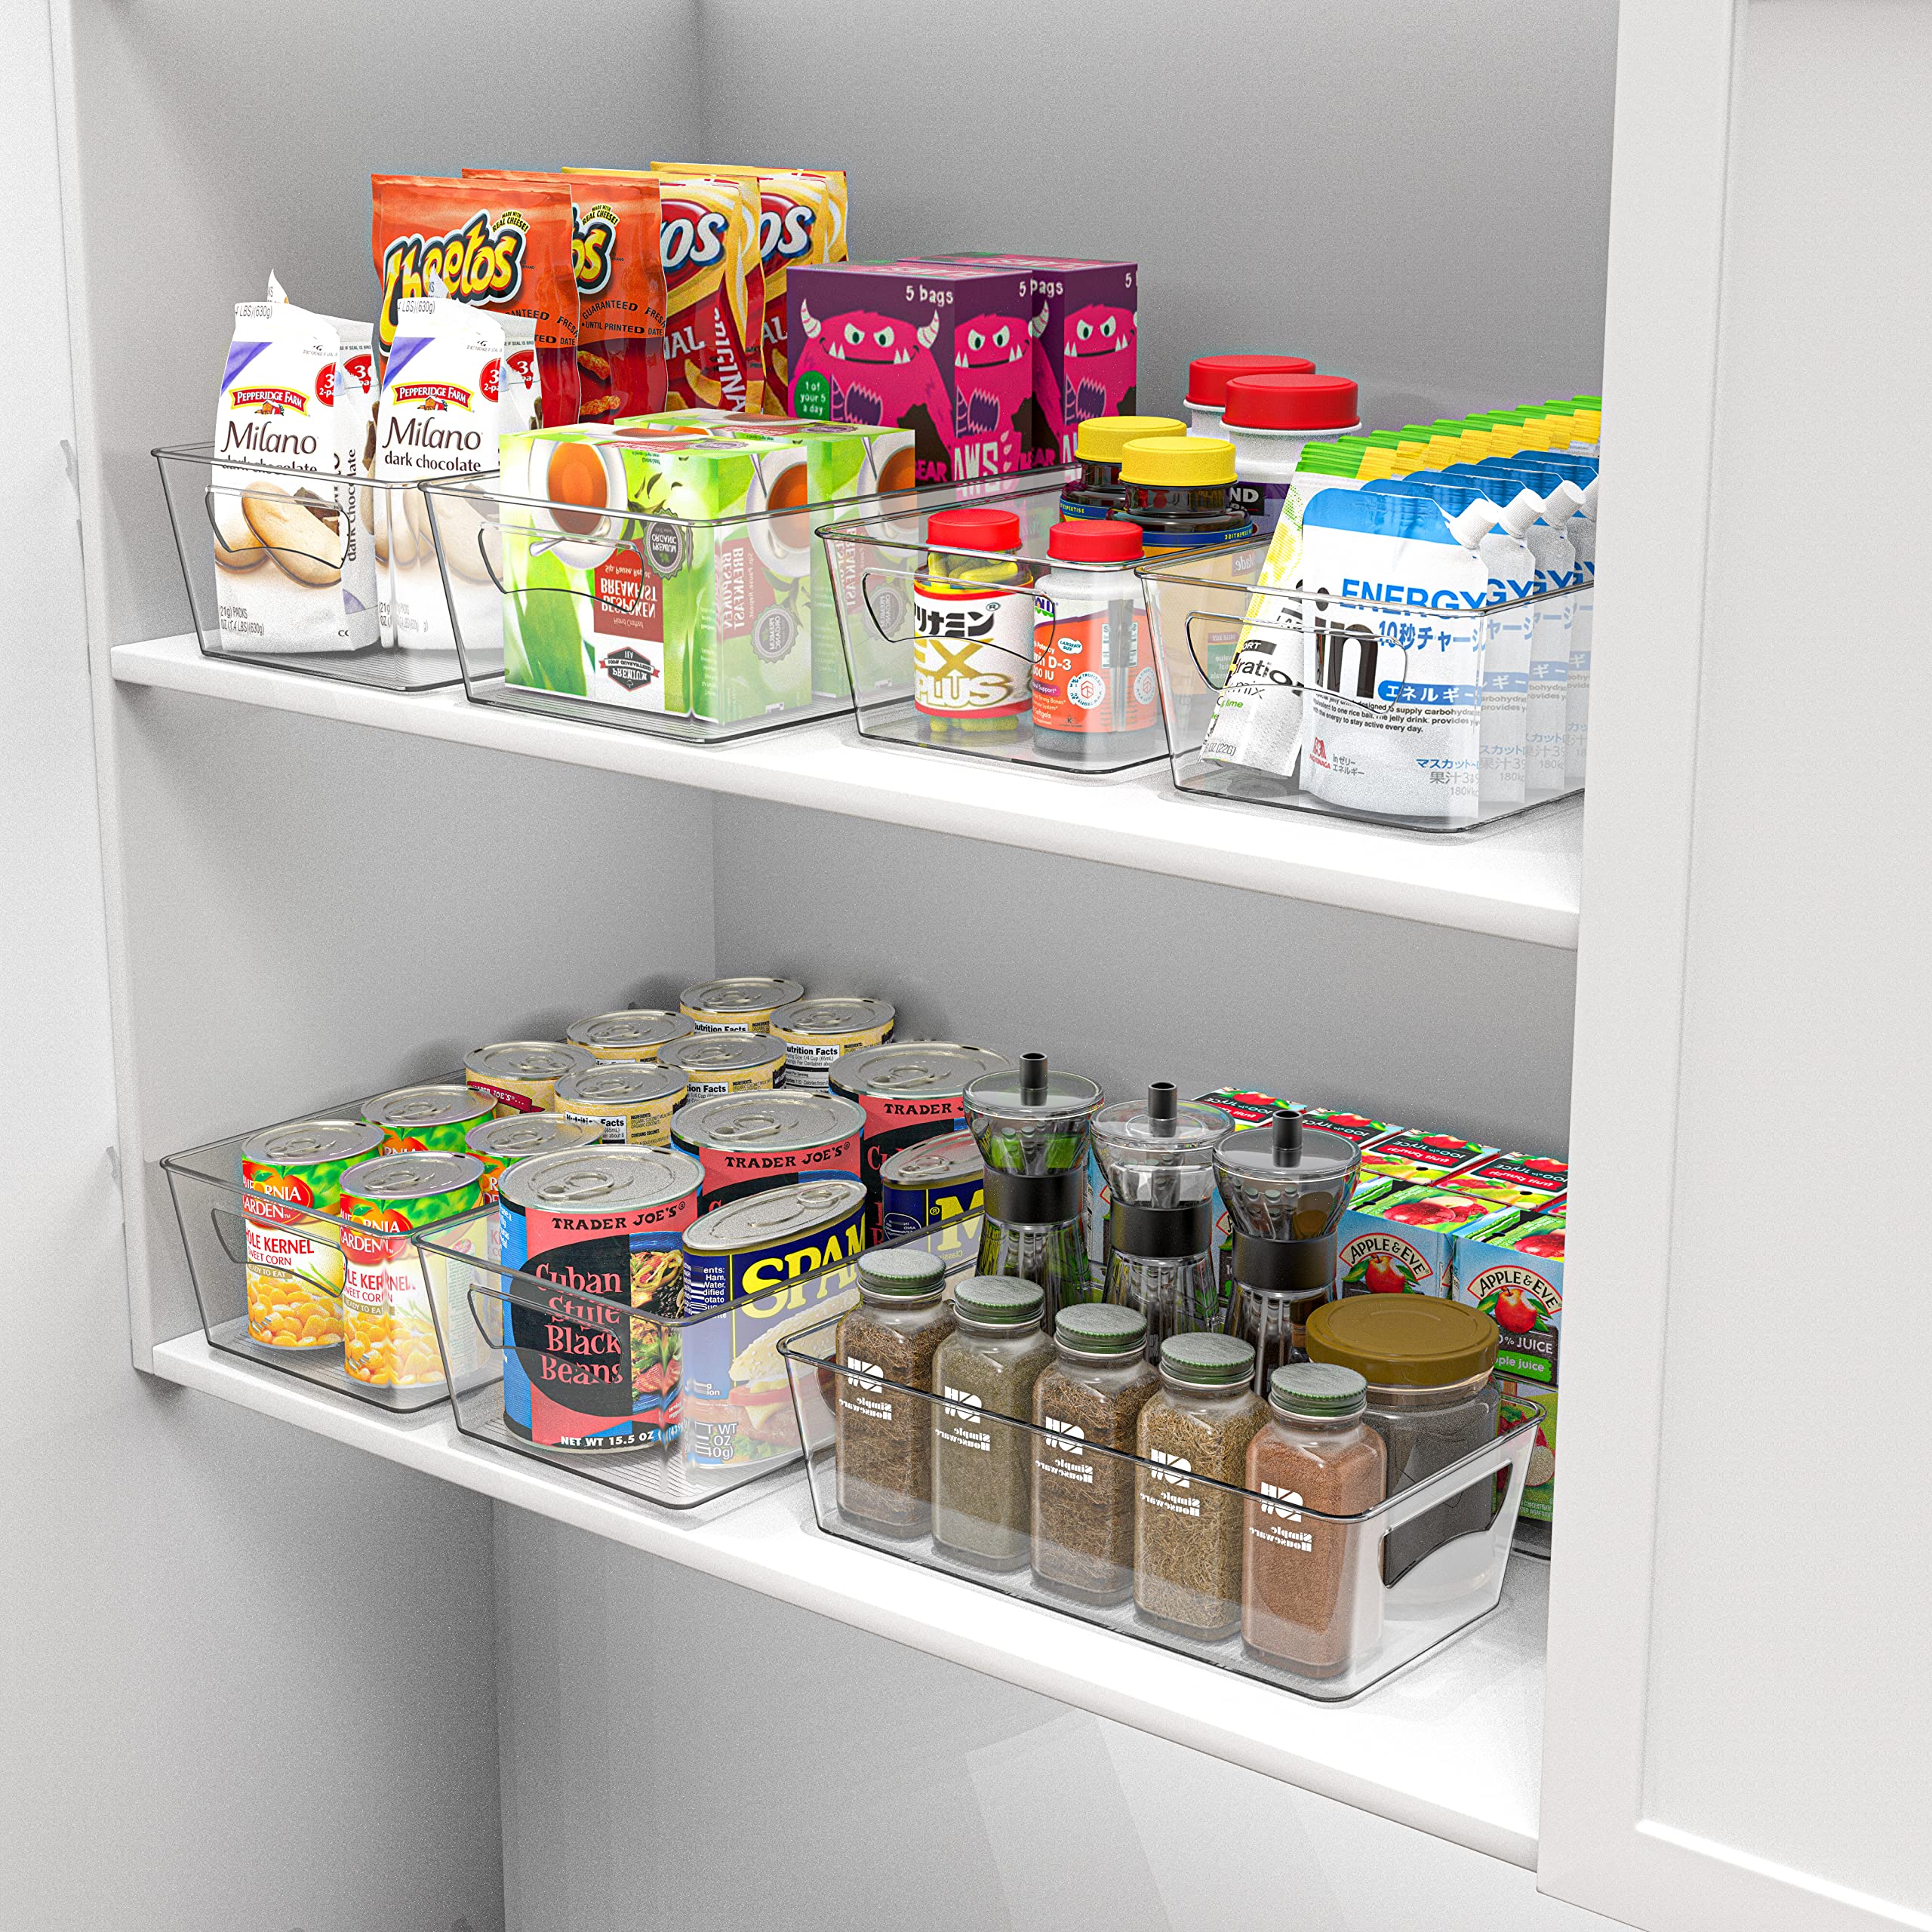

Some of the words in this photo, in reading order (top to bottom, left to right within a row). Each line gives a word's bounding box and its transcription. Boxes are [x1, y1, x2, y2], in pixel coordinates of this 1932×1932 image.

[492, 218, 506, 232] REAL
[506, 217, 528, 232] CHEESE!
[582, 214, 595, 225] REAL
[597, 210, 617, 225] CHEESE!
[1125, 274, 1132, 288] 5
[906, 285, 915, 300] 5
[920, 285, 953, 308] bags
[1019, 282, 1026, 297] 5
[582, 300, 638, 320] GUARANTEED
[586, 321, 603, 330] UNTIL
[605, 322, 645, 334] PRINTED
[648, 328, 663, 336] DATE
[560, 337, 575, 346] DATE
[811, 382, 820, 391] of
[237, 390, 283, 403] PEPPERIDGE
[285, 392, 302, 407] FARM
[399, 386, 446, 399] PEPPERIDGE
[448, 386, 466, 403] FARM
[800, 393, 819, 403] your
[820, 393, 826, 402] 5
[809, 405, 823, 414] day
[220, 420, 318, 455] Milano
[382, 417, 481, 451] Milano
[384, 451, 412, 467] dark
[416, 454, 481, 472] chocolate
[1340, 579, 1487, 620] ENERGY
[233, 606, 248, 620] PACKS
[1048, 656, 1072, 670] D-3
[1044, 669, 1054, 681] IU
[915, 672, 1014, 708] PLUS
[1226, 699, 1244, 708] lime
[1349, 709, 1360, 717] rice
[1396, 708, 1422, 716] supply
[1350, 717, 1363, 726] stay
[1364, 719, 1384, 729] active
[1385, 723, 1404, 733] every
[1407, 725, 1424, 734] day.
[786, 1046, 814, 1055] utrition
[703, 1084, 727, 1093] Facts
[884, 1103, 952, 1115] TRADER
[601, 1118, 624, 1127] Facts
[725, 1155, 795, 1169] TRADER
[801, 1143, 843, 1164] JOE'S
[552, 1217, 626, 1231] TRADER
[632, 1206, 678, 1226] JOE'S
[264, 1236, 315, 1254] KERNEL
[266, 1254, 291, 1266] CORN
[1350, 1238, 1390, 1265] APPLE
[1392, 1241, 1401, 1254] &
[1402, 1245, 1426, 1275] EVE
[272, 1269, 287, 1278] EAT
[536, 1263, 622, 1294] Cuban
[706, 1274, 726, 1282] Ham,
[1480, 1271, 1521, 1297] APPLE
[1522, 1274, 1532, 1286] &
[1533, 1278, 1558, 1309] EVE
[545, 1324, 622, 1355] Black
[1517, 1336, 1553, 1354] JUICE
[539, 1354, 623, 1385] Beans
[1518, 1357, 1545, 1373] juice
[718, 1423, 737, 1435] WT
[561, 1435, 582, 1446] NET
[585, 1438, 603, 1447] WT
[608, 1435, 635, 1446] 15.5
[638, 1431, 654, 1441] OZ
[715, 1435, 731, 1447] OZ
